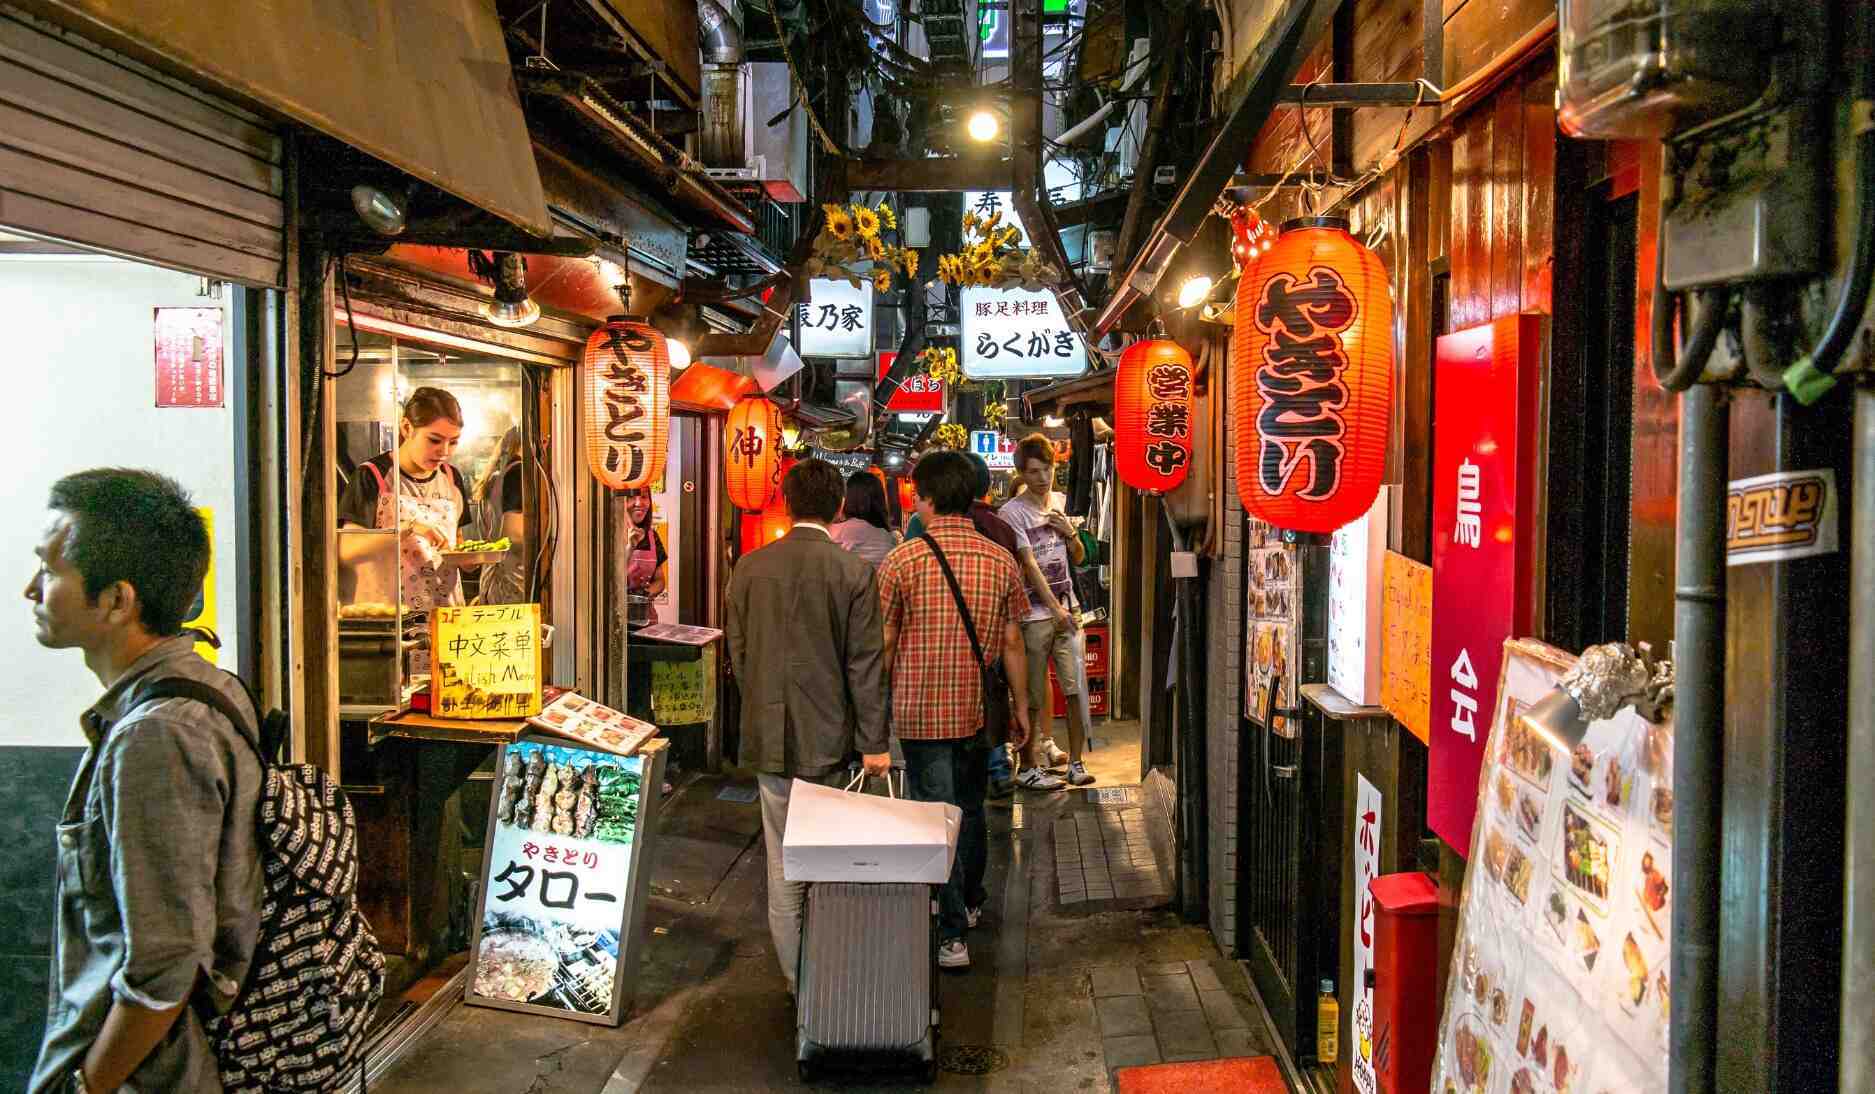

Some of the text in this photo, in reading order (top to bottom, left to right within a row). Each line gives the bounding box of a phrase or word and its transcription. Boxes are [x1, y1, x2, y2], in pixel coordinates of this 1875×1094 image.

[976, 300, 1048, 317] 豚足料理
[976, 327, 1074, 359] らくがき
[1254, 266, 1359, 501] やきとり
[597, 328, 655, 482] やきとり
[1146, 363, 1191, 476] 営業中
[472, 607, 523, 623] テーブル
[448, 629, 532, 661] 中文菜单
[523, 841, 598, 869] やきとり
[494, 860, 617, 909] タロー
